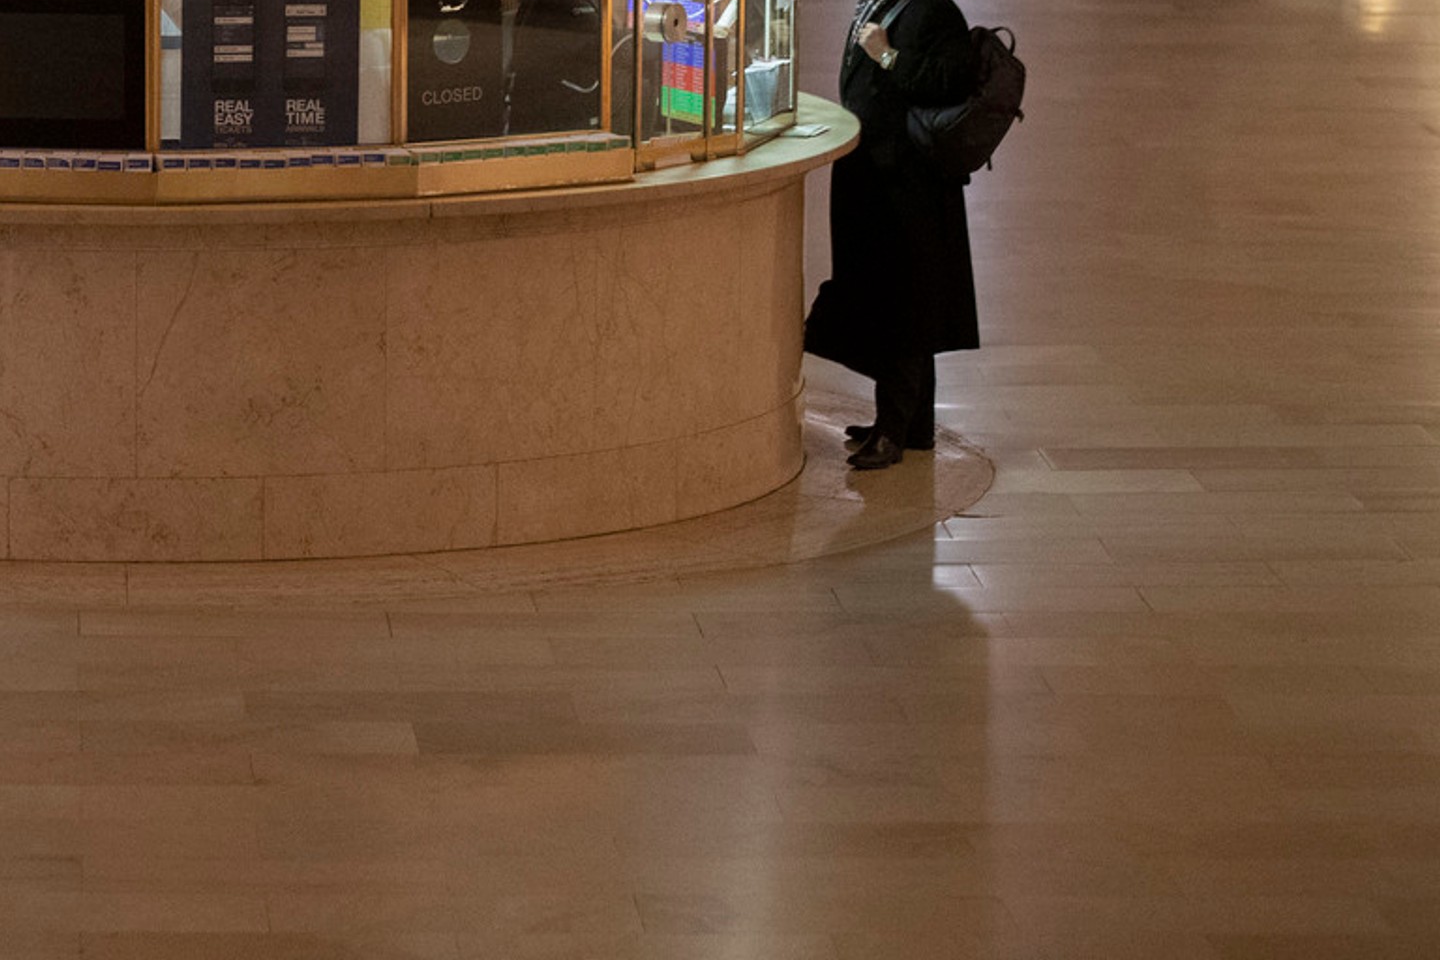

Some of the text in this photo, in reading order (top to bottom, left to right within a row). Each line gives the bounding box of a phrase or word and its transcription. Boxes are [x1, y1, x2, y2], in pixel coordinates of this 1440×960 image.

[421, 85, 483, 106] CLOSED
[214, 99, 254, 112] REAL
[286, 99, 325, 112] REAL
[214, 112, 254, 125] EASY
[286, 112, 325, 125] TIME
